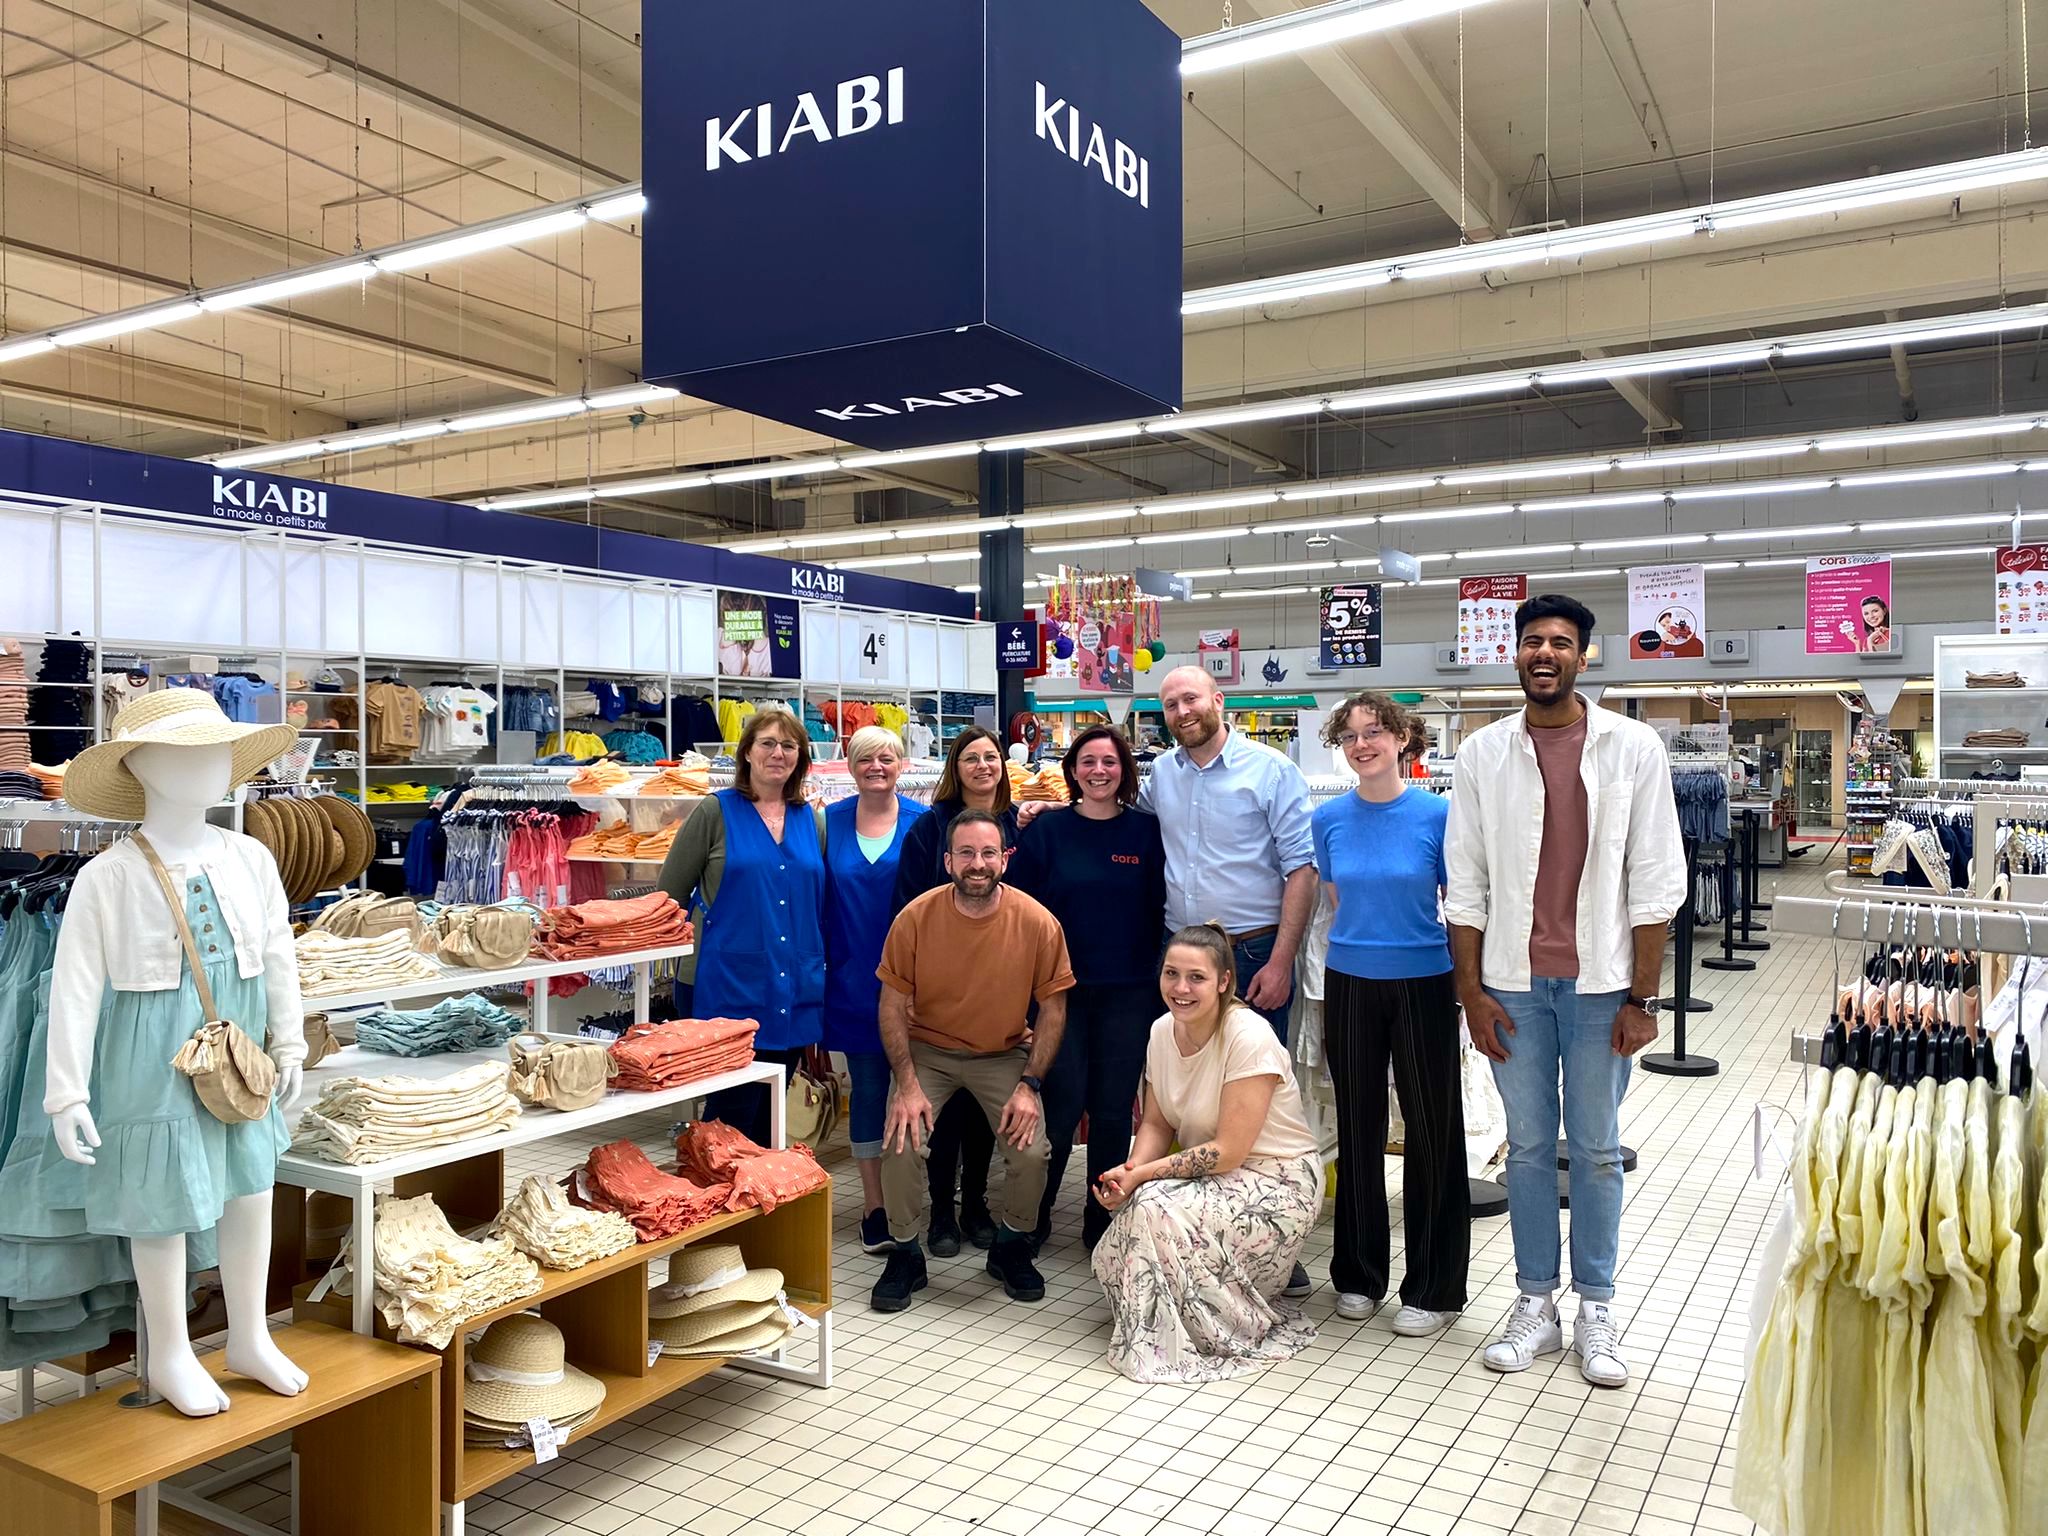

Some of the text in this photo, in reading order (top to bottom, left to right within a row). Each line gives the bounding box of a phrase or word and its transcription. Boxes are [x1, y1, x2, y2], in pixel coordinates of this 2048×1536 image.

[706, 66, 904, 171] KIABI
[1035, 80, 1149, 208] KIABI
[815, 383, 1024, 421] KIABI
[213, 475, 327, 518] KIABI
[213, 507, 326, 530] la mode à petits prix
[1820, 557, 1846, 565] cora
[792, 567, 844, 594] KIABI
[1491, 584, 1518, 592] GAGNER
[725, 611, 762, 620] UNE MODE
[725, 621, 755, 630] DURABLE
[725, 631, 745, 640] PETITS
[1007, 640, 1026, 650] BÉBÉ
[1726, 641, 1733, 653] 6
[1449, 650, 1456, 662] 8
[1212, 660, 1223, 671] 10
[1111, 854, 1140, 864] cora
